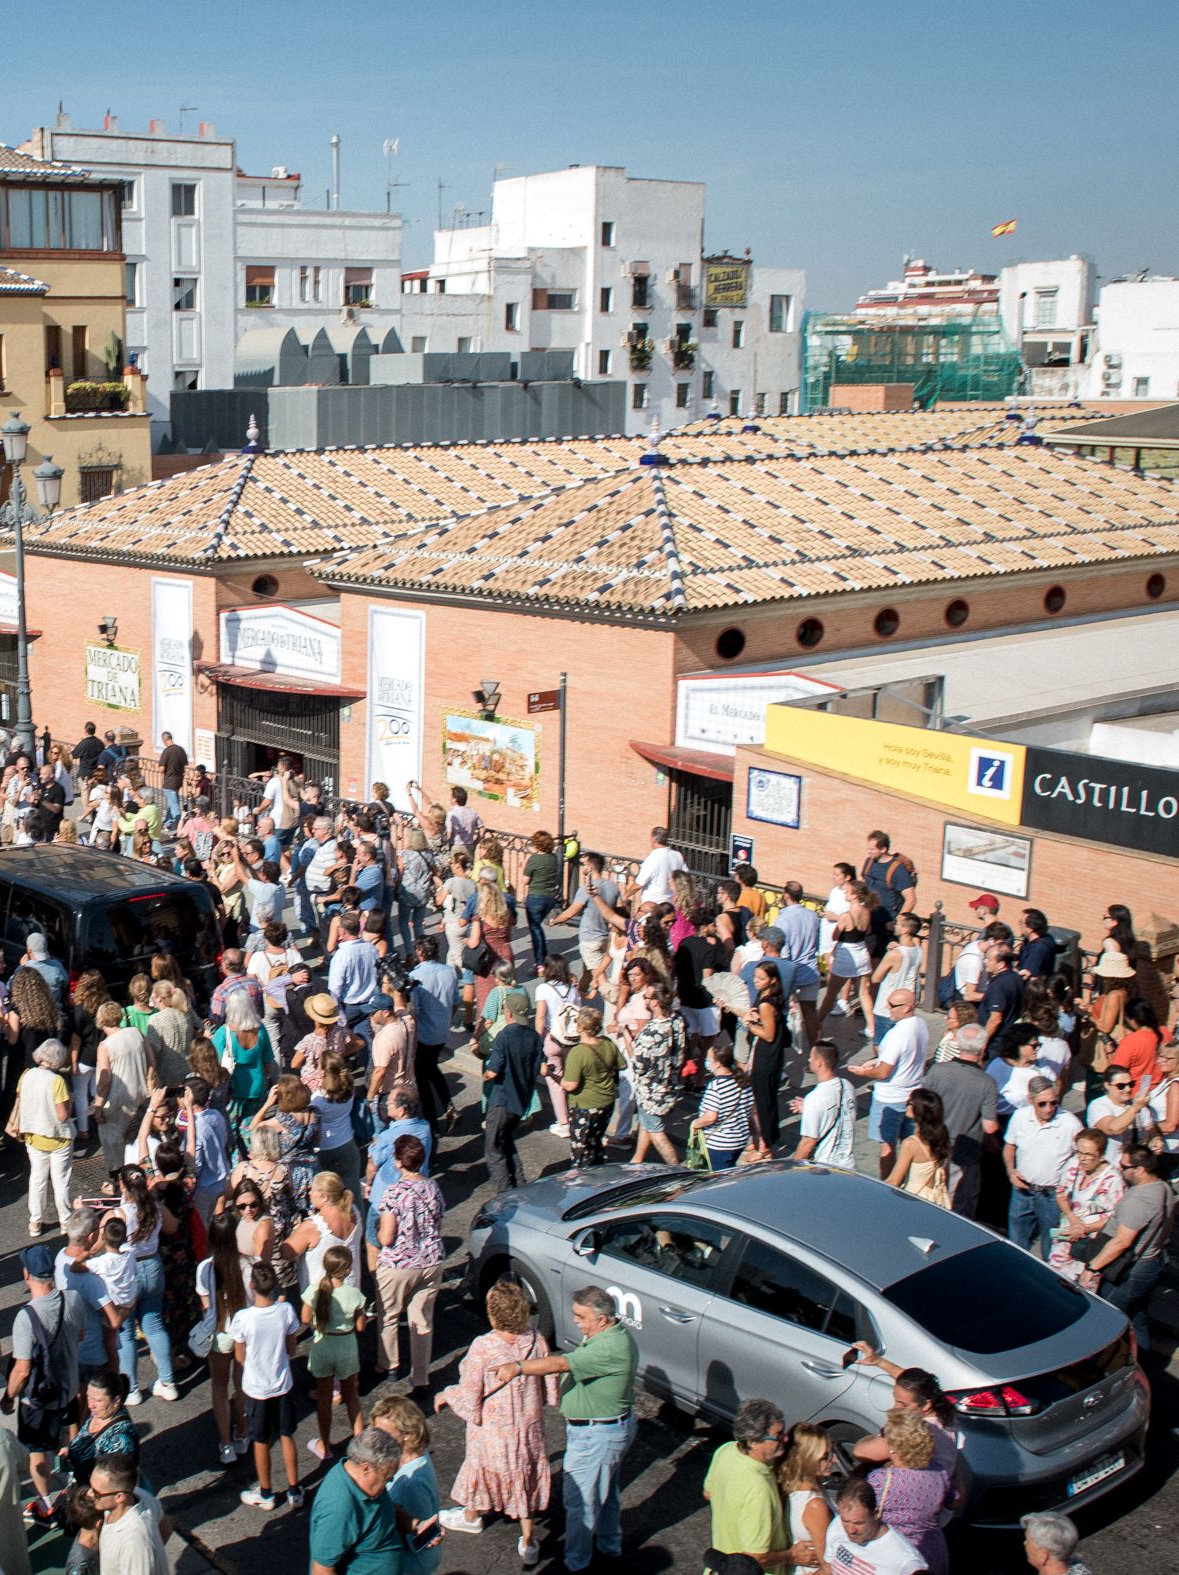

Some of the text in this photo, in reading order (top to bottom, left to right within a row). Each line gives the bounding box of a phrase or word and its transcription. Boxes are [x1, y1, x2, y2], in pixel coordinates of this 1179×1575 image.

[237, 627, 279, 651] MERCADO
[286, 633, 324, 665] TRIANA
[87, 648, 138, 673] MERCADO
[107, 671, 119, 683] DE
[88, 679, 137, 707] TRIANA
[376, 718, 410, 740] 200
[883, 742, 903, 753] Hola
[905, 747, 920, 758] soy
[885, 758, 901, 768] soy
[902, 761, 921, 772] muy
[1034, 773, 1179, 819] CASTILLO
